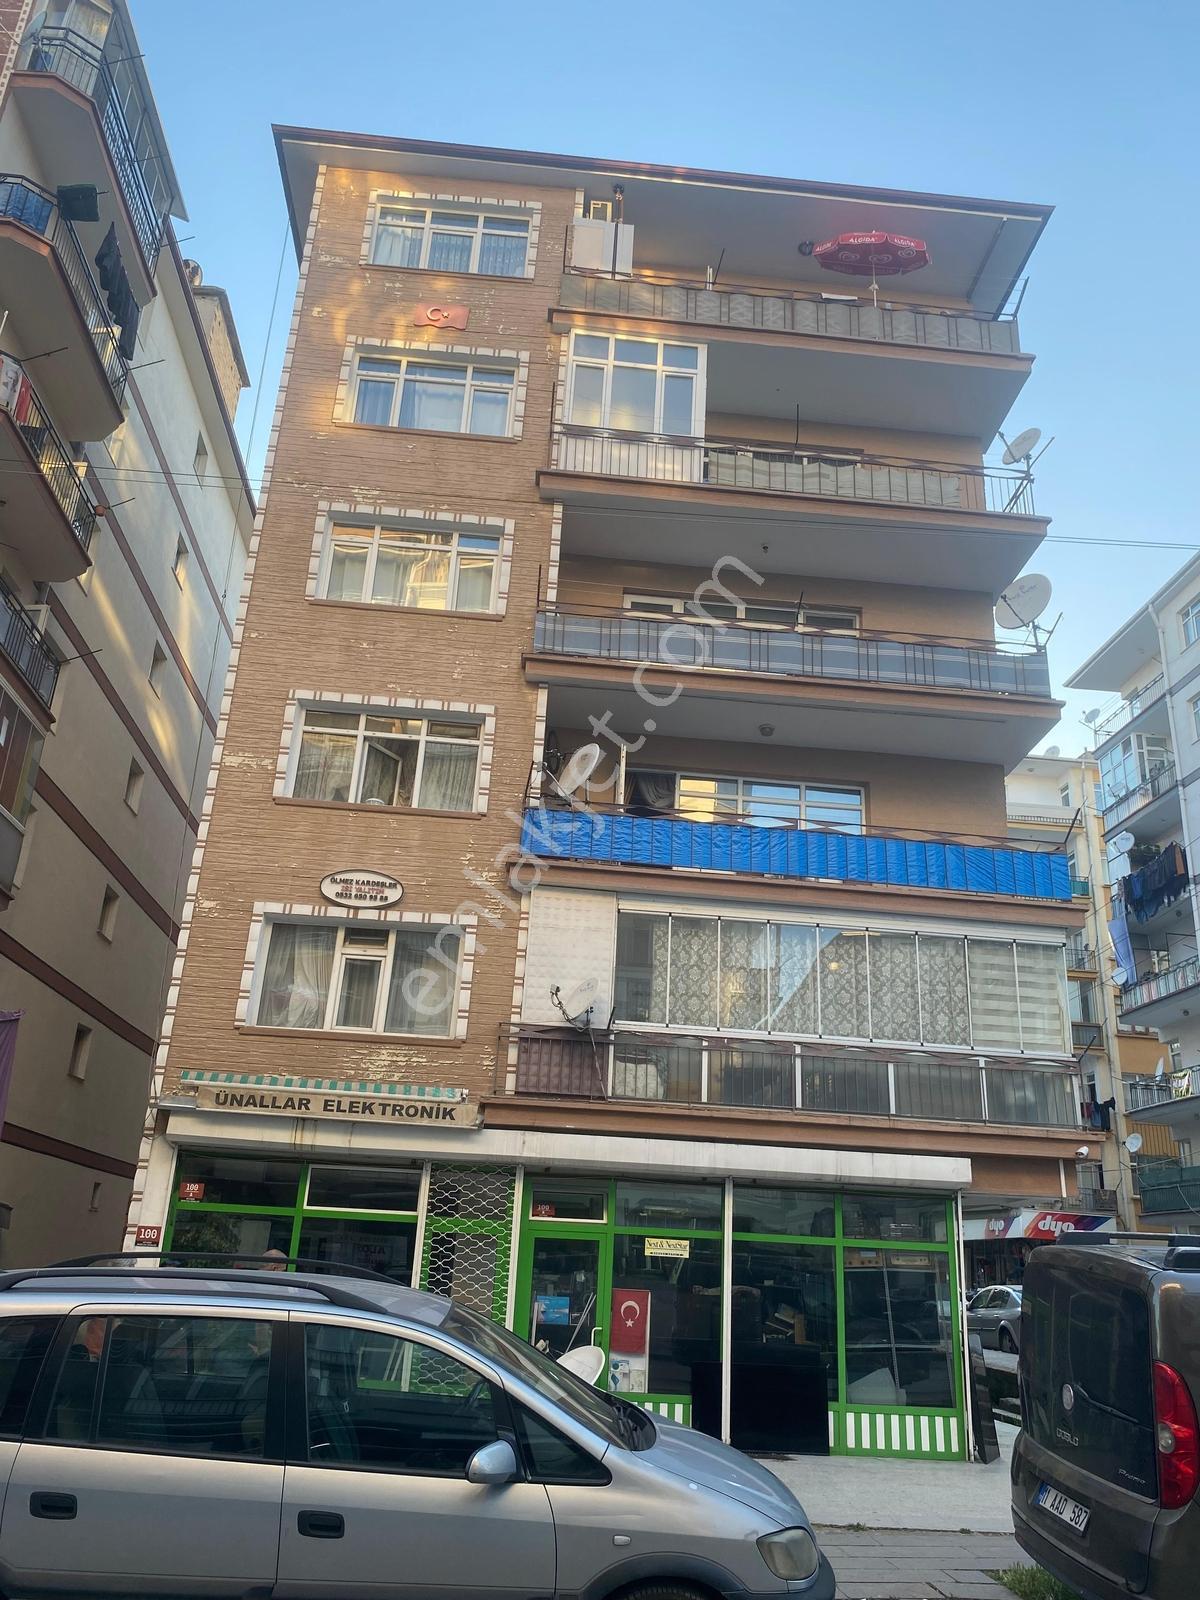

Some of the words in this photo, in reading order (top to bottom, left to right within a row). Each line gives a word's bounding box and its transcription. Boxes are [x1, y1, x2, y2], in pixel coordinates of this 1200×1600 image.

[214, 1090, 311, 1111] ÜNALLAR
[323, 1099, 456, 1121] ELEKTRONİK
[186, 1183, 199, 1191] 100
[139, 1229, 158, 1239] 100
[989, 1218, 1005, 1235] dyo
[1038, 1215, 1075, 1236] dyo
[1049, 1492, 1068, 1516] AAD
[1069, 1503, 1089, 1528] 587
